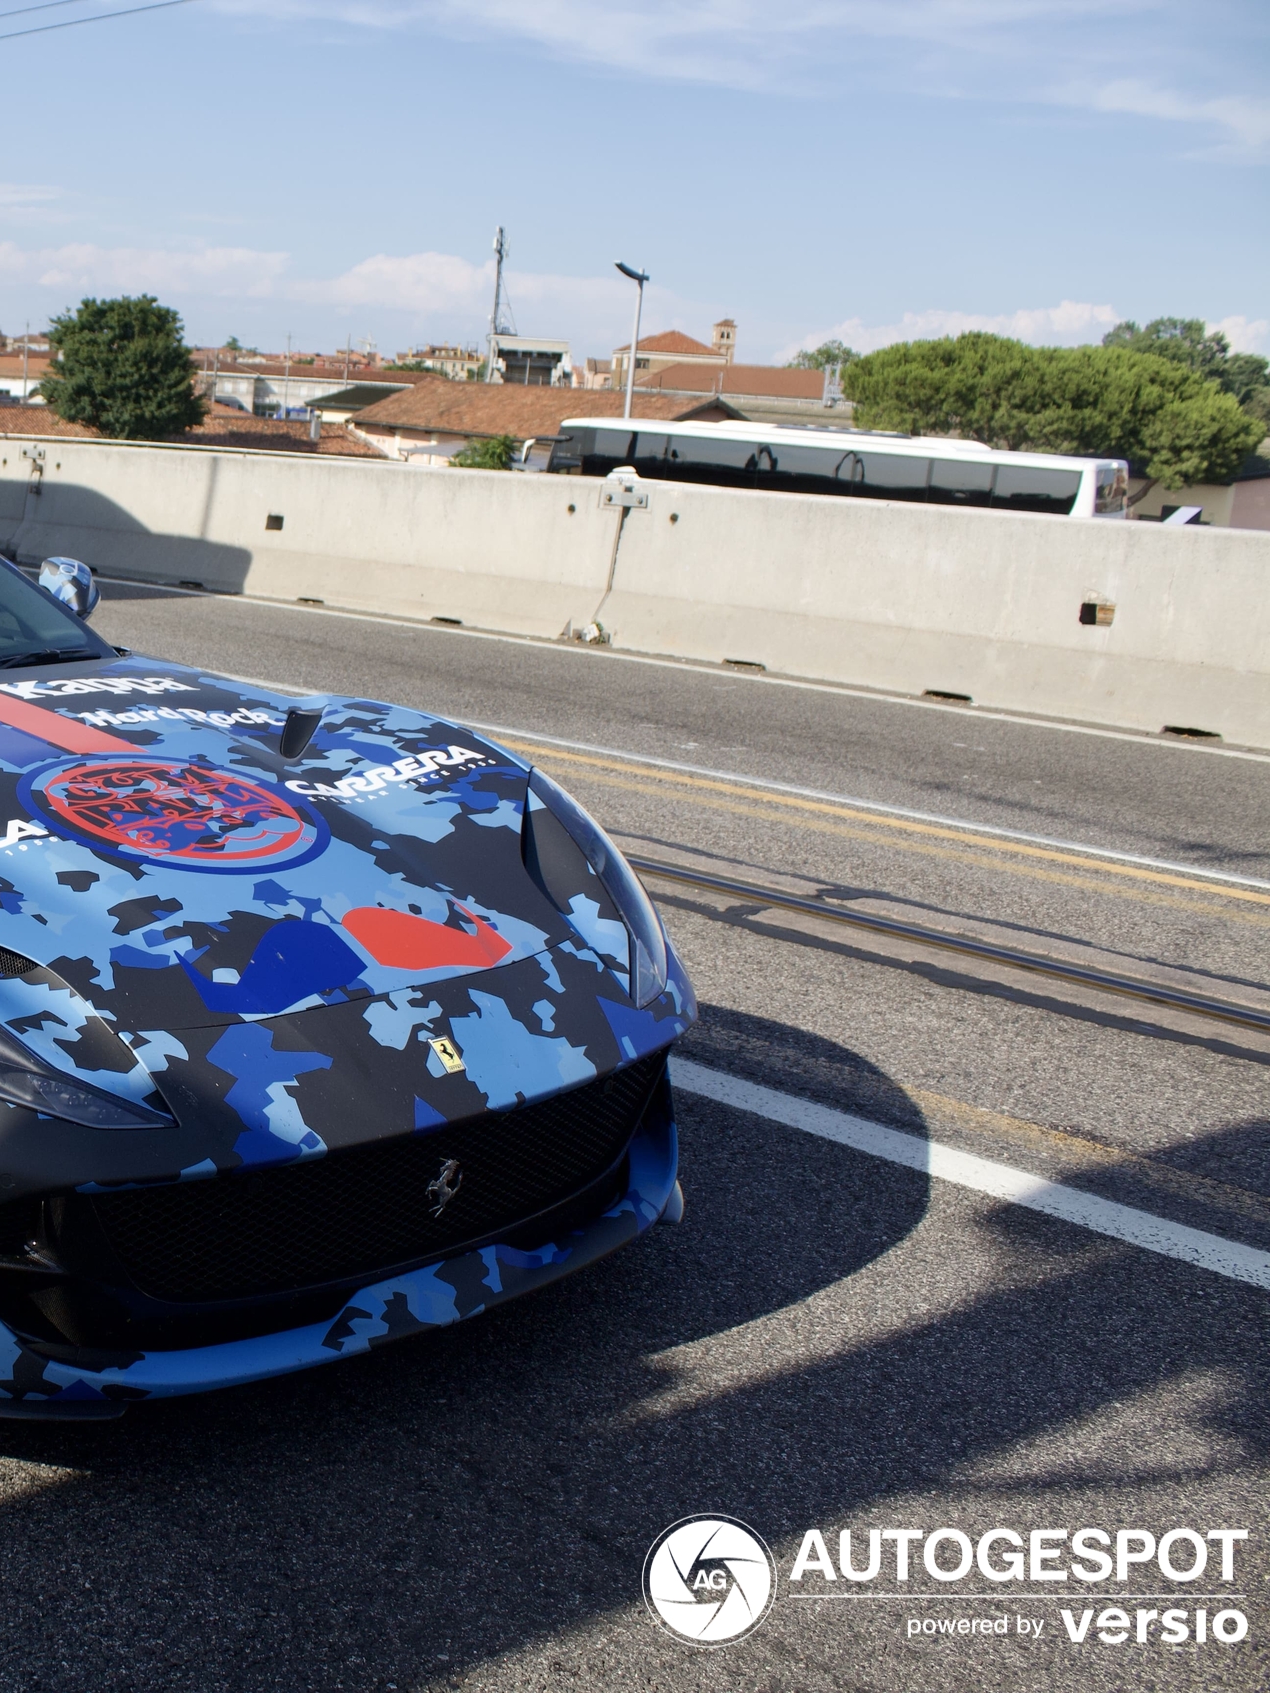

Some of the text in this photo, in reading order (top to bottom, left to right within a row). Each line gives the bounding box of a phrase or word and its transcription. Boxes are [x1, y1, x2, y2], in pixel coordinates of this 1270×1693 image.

[79, 705, 286, 728] Hard Rock
[285, 745, 486, 798] CARRERA
[398, 769, 451, 790] SINCE
